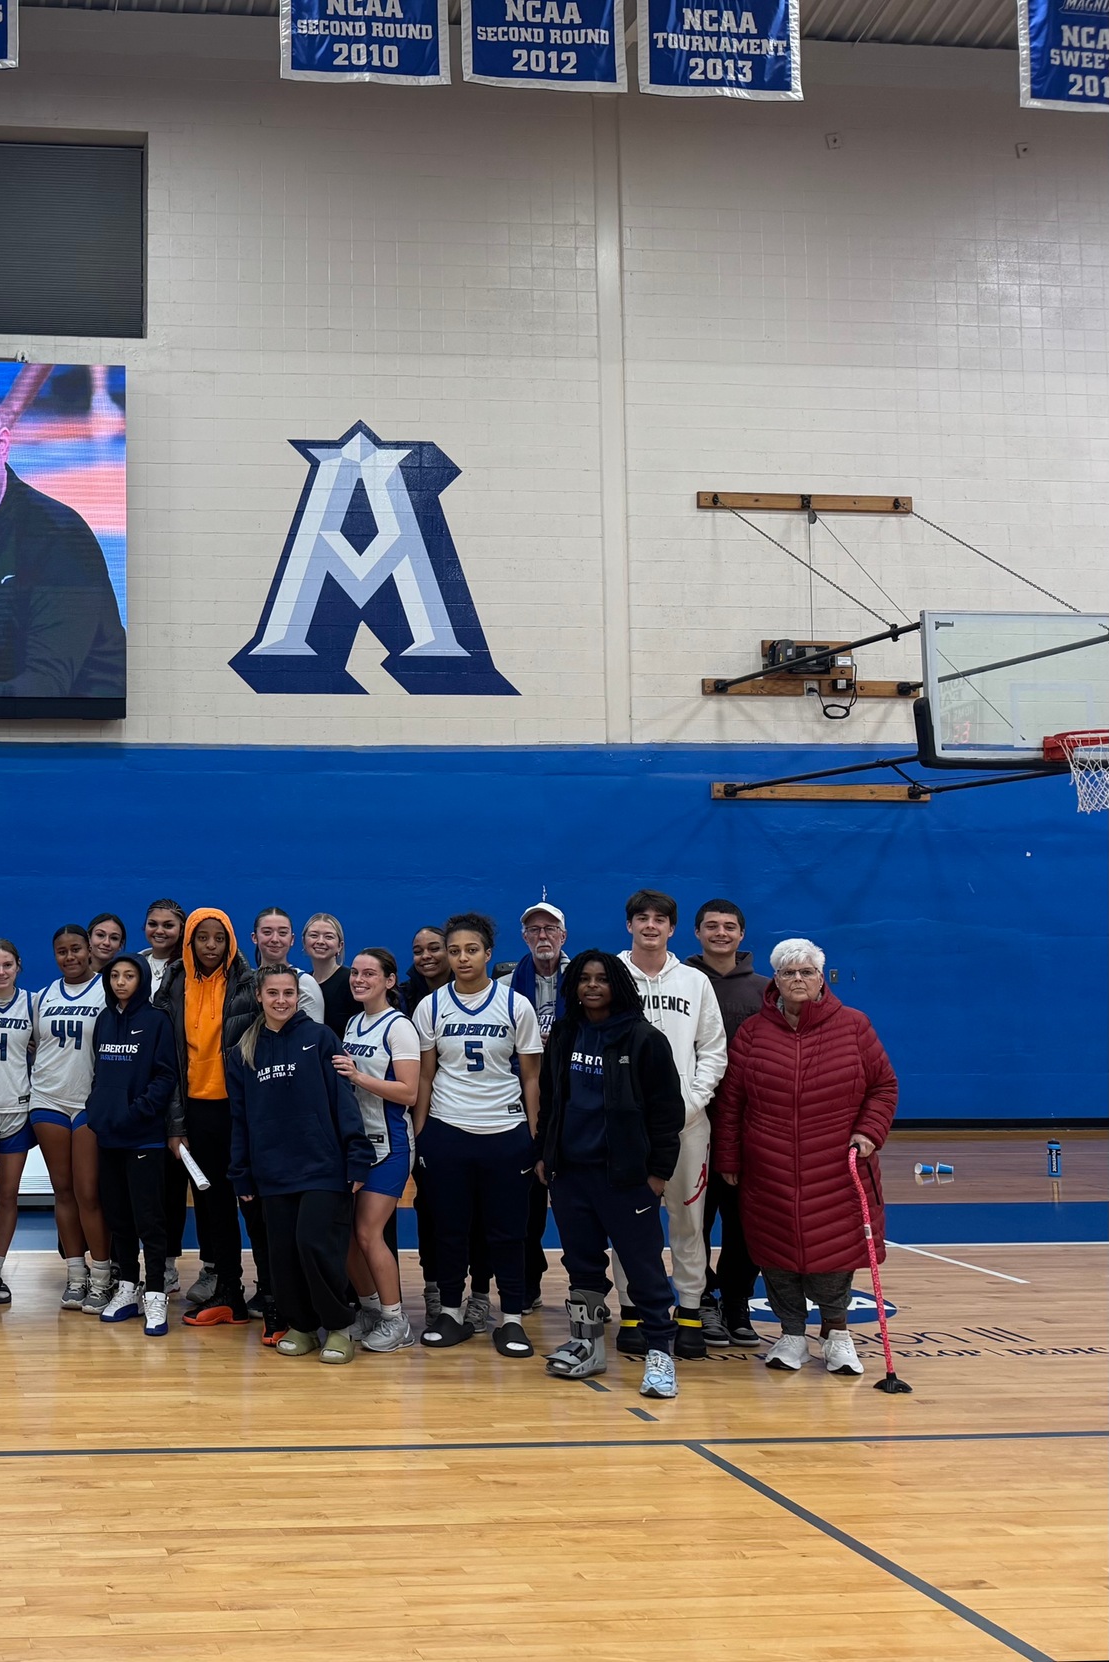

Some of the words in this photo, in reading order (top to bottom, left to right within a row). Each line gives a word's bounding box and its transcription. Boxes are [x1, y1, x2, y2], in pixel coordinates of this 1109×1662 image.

[326, 0, 404, 18] NCAA
[505, 0, 582, 24] NCAA
[682, 8, 758, 34] NCAA
[297, 19, 366, 36] SECOND
[371, 22, 433, 40] ROUND
[477, 26, 544, 43] SECOND
[549, 28, 610, 45] ROUND
[332, 43, 399, 68] 2010
[653, 32, 787, 56] TOURNAMENT
[512, 49, 578, 74] 2012
[689, 57, 753, 83] 2013
[1050, 48, 1109, 69] SWEE
[43, 1006, 99, 1018] ALBERTUS
[51, 1020, 83, 1050] 44
[441, 1023, 509, 1038] ALBERTUS
[464, 1041, 485, 1072] 5
